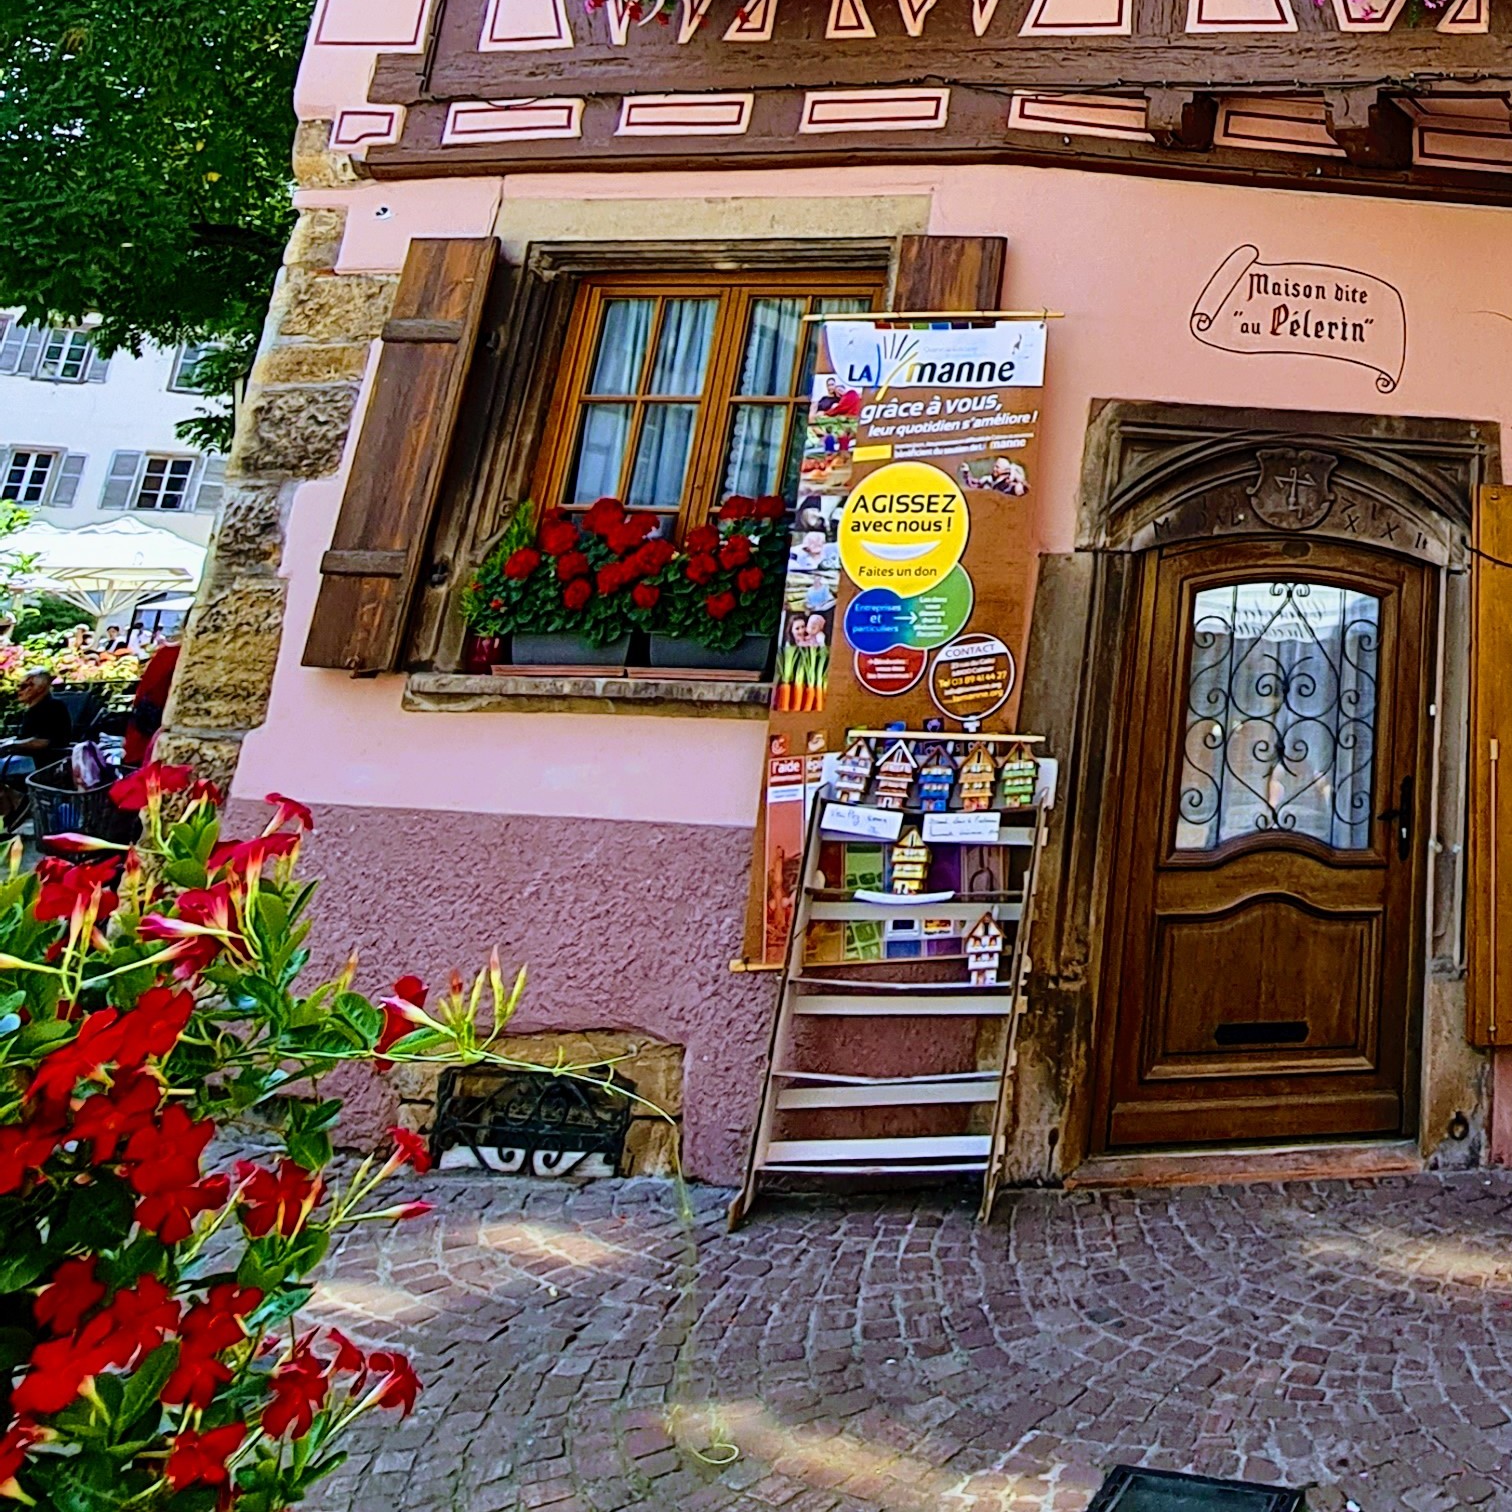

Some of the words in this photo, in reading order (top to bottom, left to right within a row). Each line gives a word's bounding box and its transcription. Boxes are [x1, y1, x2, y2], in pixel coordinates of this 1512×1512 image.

[1246, 272, 1327, 302] Maison
[1334, 282, 1369, 304] dite
[847, 363, 873, 382] LA
[905, 360, 1016, 383] manne
[860, 396, 923, 425] grâce
[926, 394, 942, 415] à
[944, 393, 1003, 414] vous,
[868, 424, 896, 438] leur
[896, 418, 961, 437] quotidien
[989, 439, 1027, 450] manne
[851, 494, 957, 514] AGISSEZ
[850, 520, 893, 532] avec
[896, 520, 943, 532] nous
[858, 566, 894, 577] Faites
[896, 569, 912, 577] un
[914, 566, 937, 577] don
[855, 604, 902, 612] Entreprises
[869, 614, 882, 624] et
[852, 625, 899, 634] particuliers
[945, 643, 996, 658] CONTACT
